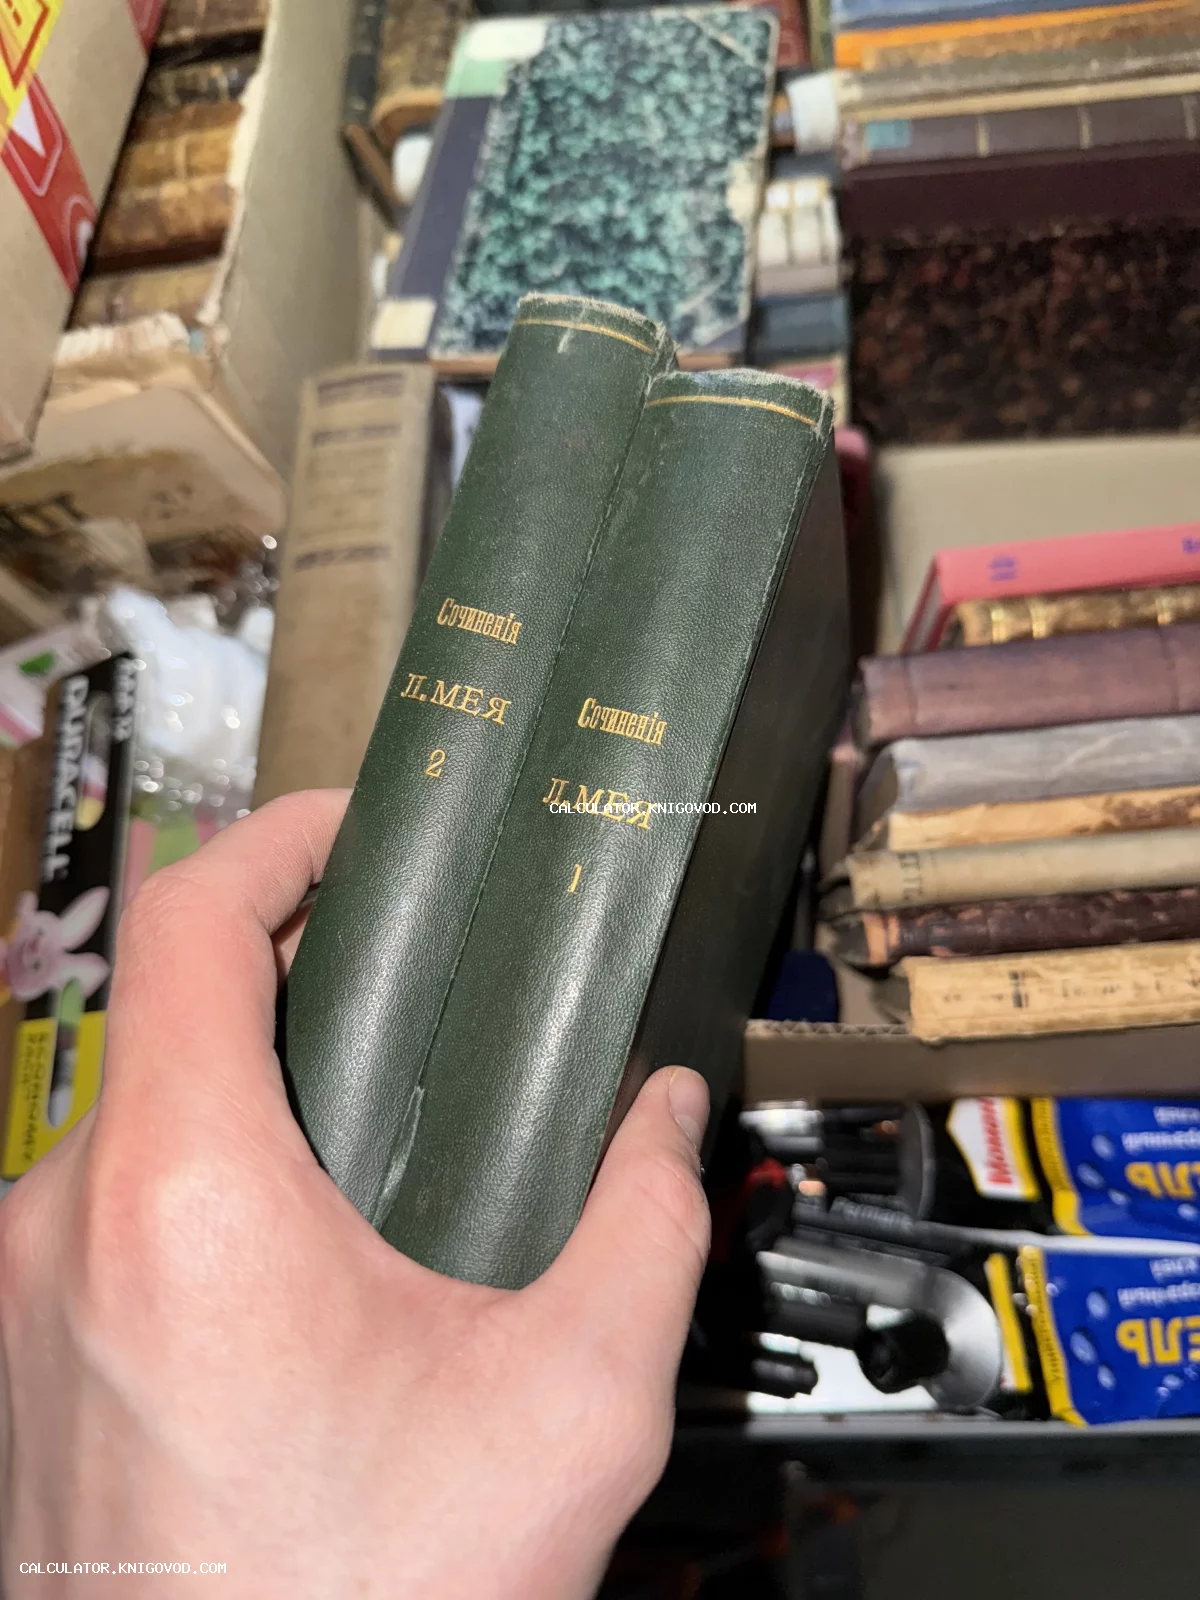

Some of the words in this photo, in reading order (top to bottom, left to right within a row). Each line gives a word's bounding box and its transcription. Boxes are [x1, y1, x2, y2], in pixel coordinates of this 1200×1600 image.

[437, 598, 523, 645] Сочиненія
[577, 697, 668, 745] Сочиненія
[43, 674, 89, 882] DURACELL
[425, 749, 446, 778] 2
[568, 864, 583, 893] 1
